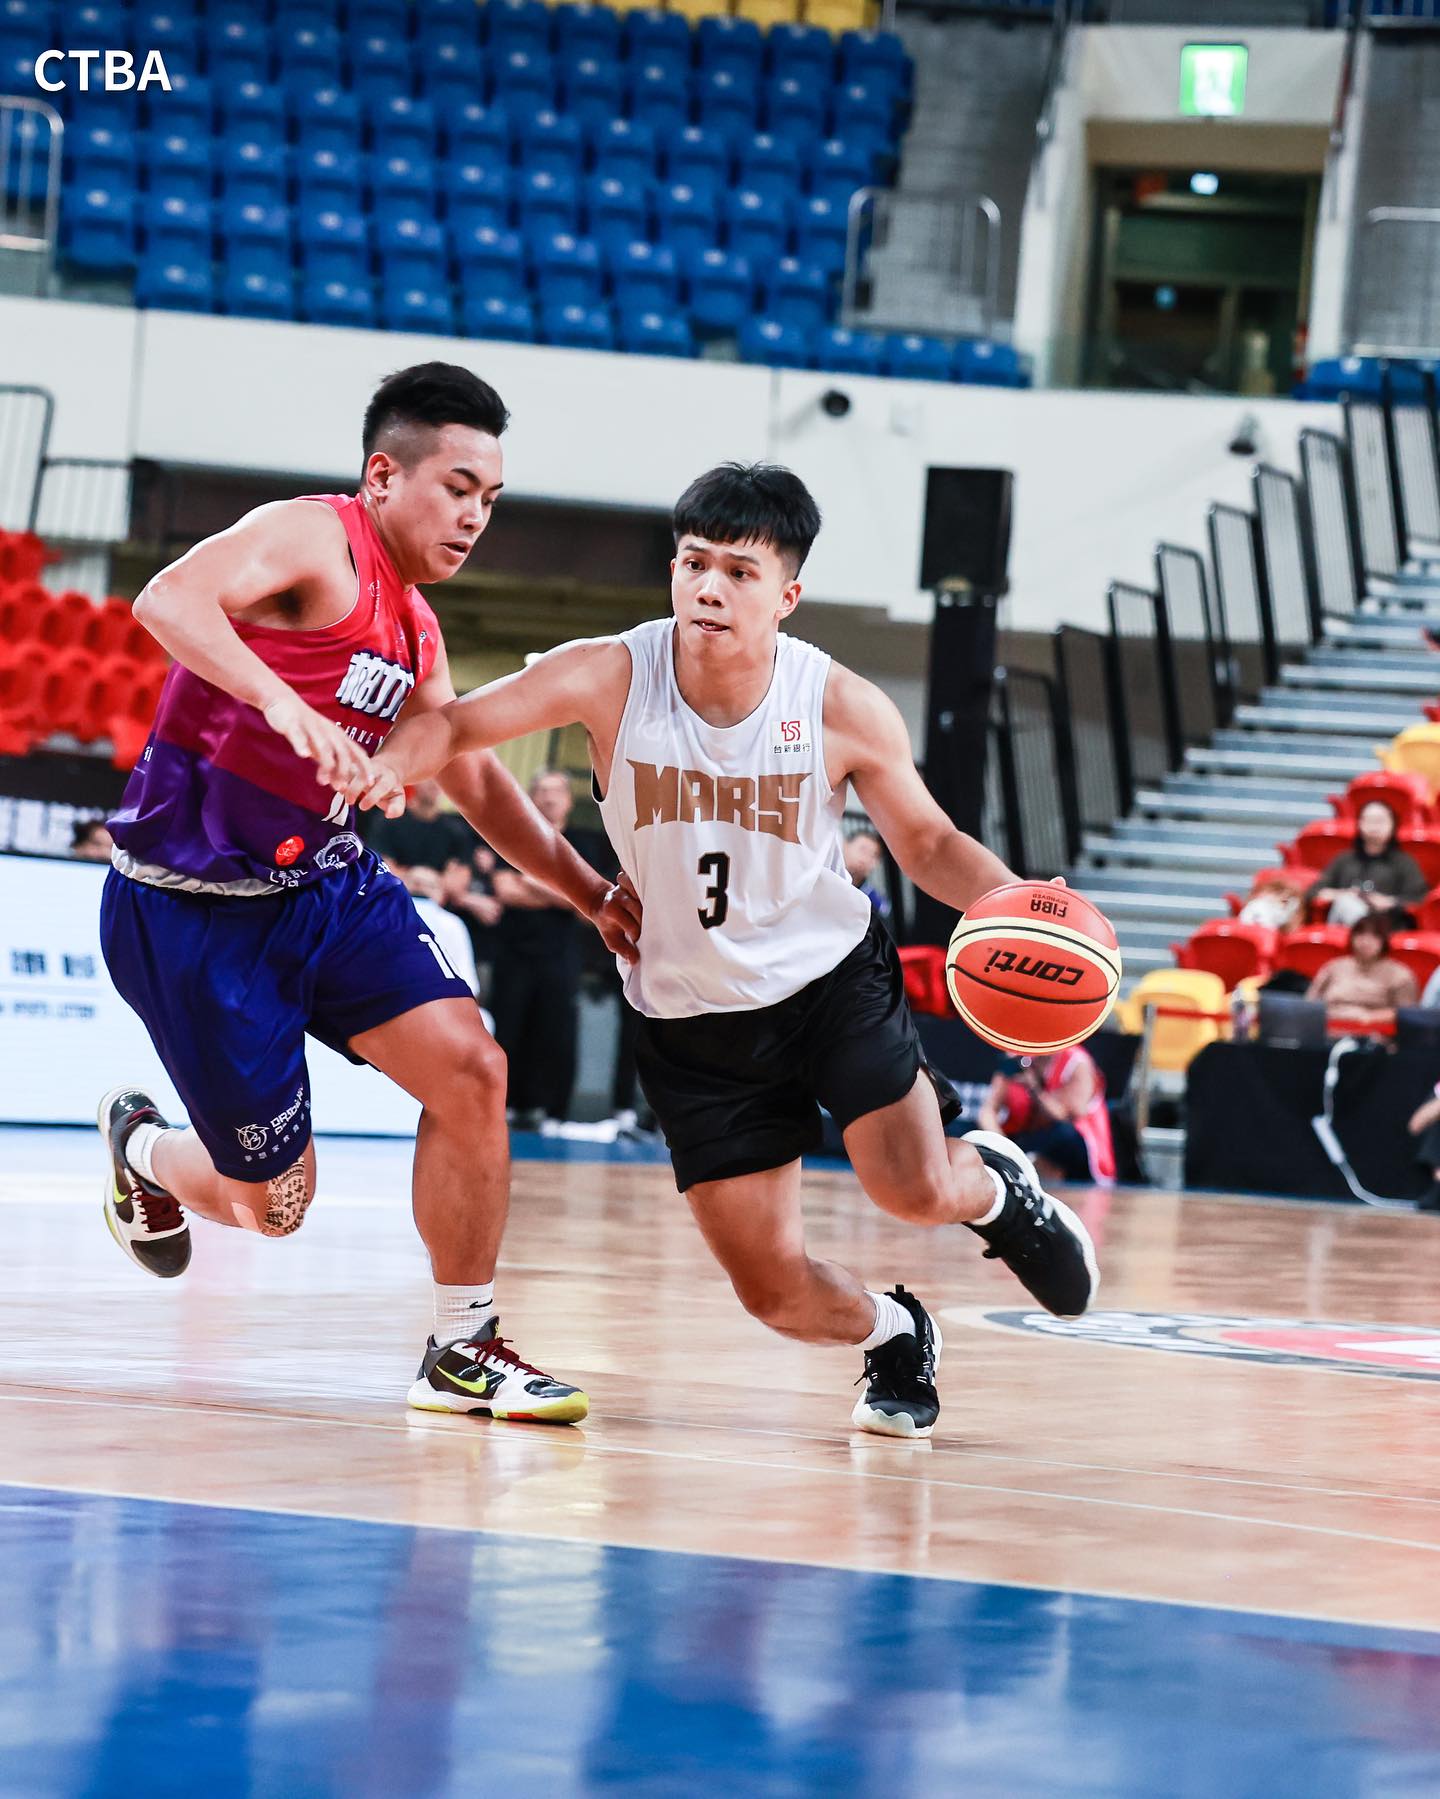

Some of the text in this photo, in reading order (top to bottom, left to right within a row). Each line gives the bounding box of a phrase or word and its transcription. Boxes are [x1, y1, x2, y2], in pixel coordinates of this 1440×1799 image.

[626, 758, 813, 845] MARS
[697, 851, 730, 930] 3
[1030, 899, 1067, 918] FIBA
[983, 950, 1084, 986] conti
